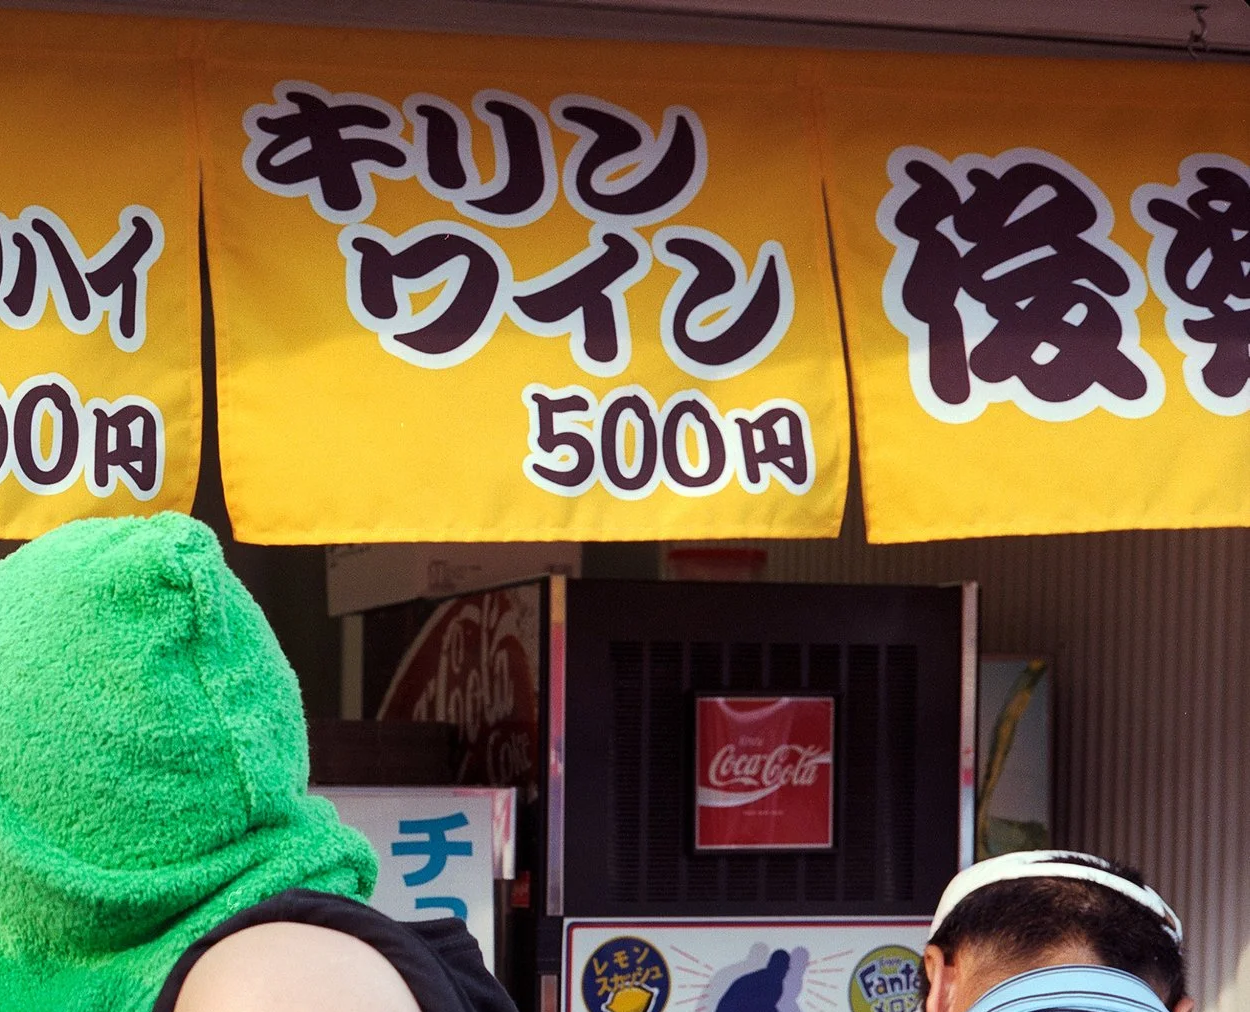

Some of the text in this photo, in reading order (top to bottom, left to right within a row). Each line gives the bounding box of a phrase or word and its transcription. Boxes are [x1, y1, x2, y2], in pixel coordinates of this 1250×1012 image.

[256, 91, 697, 216] キリン
[351, 232, 782, 367] ワイン
[530, 392, 809, 491] 500円
[708, 744, 822, 787] Coca-Cola
[592, 946, 650, 976] レモン
